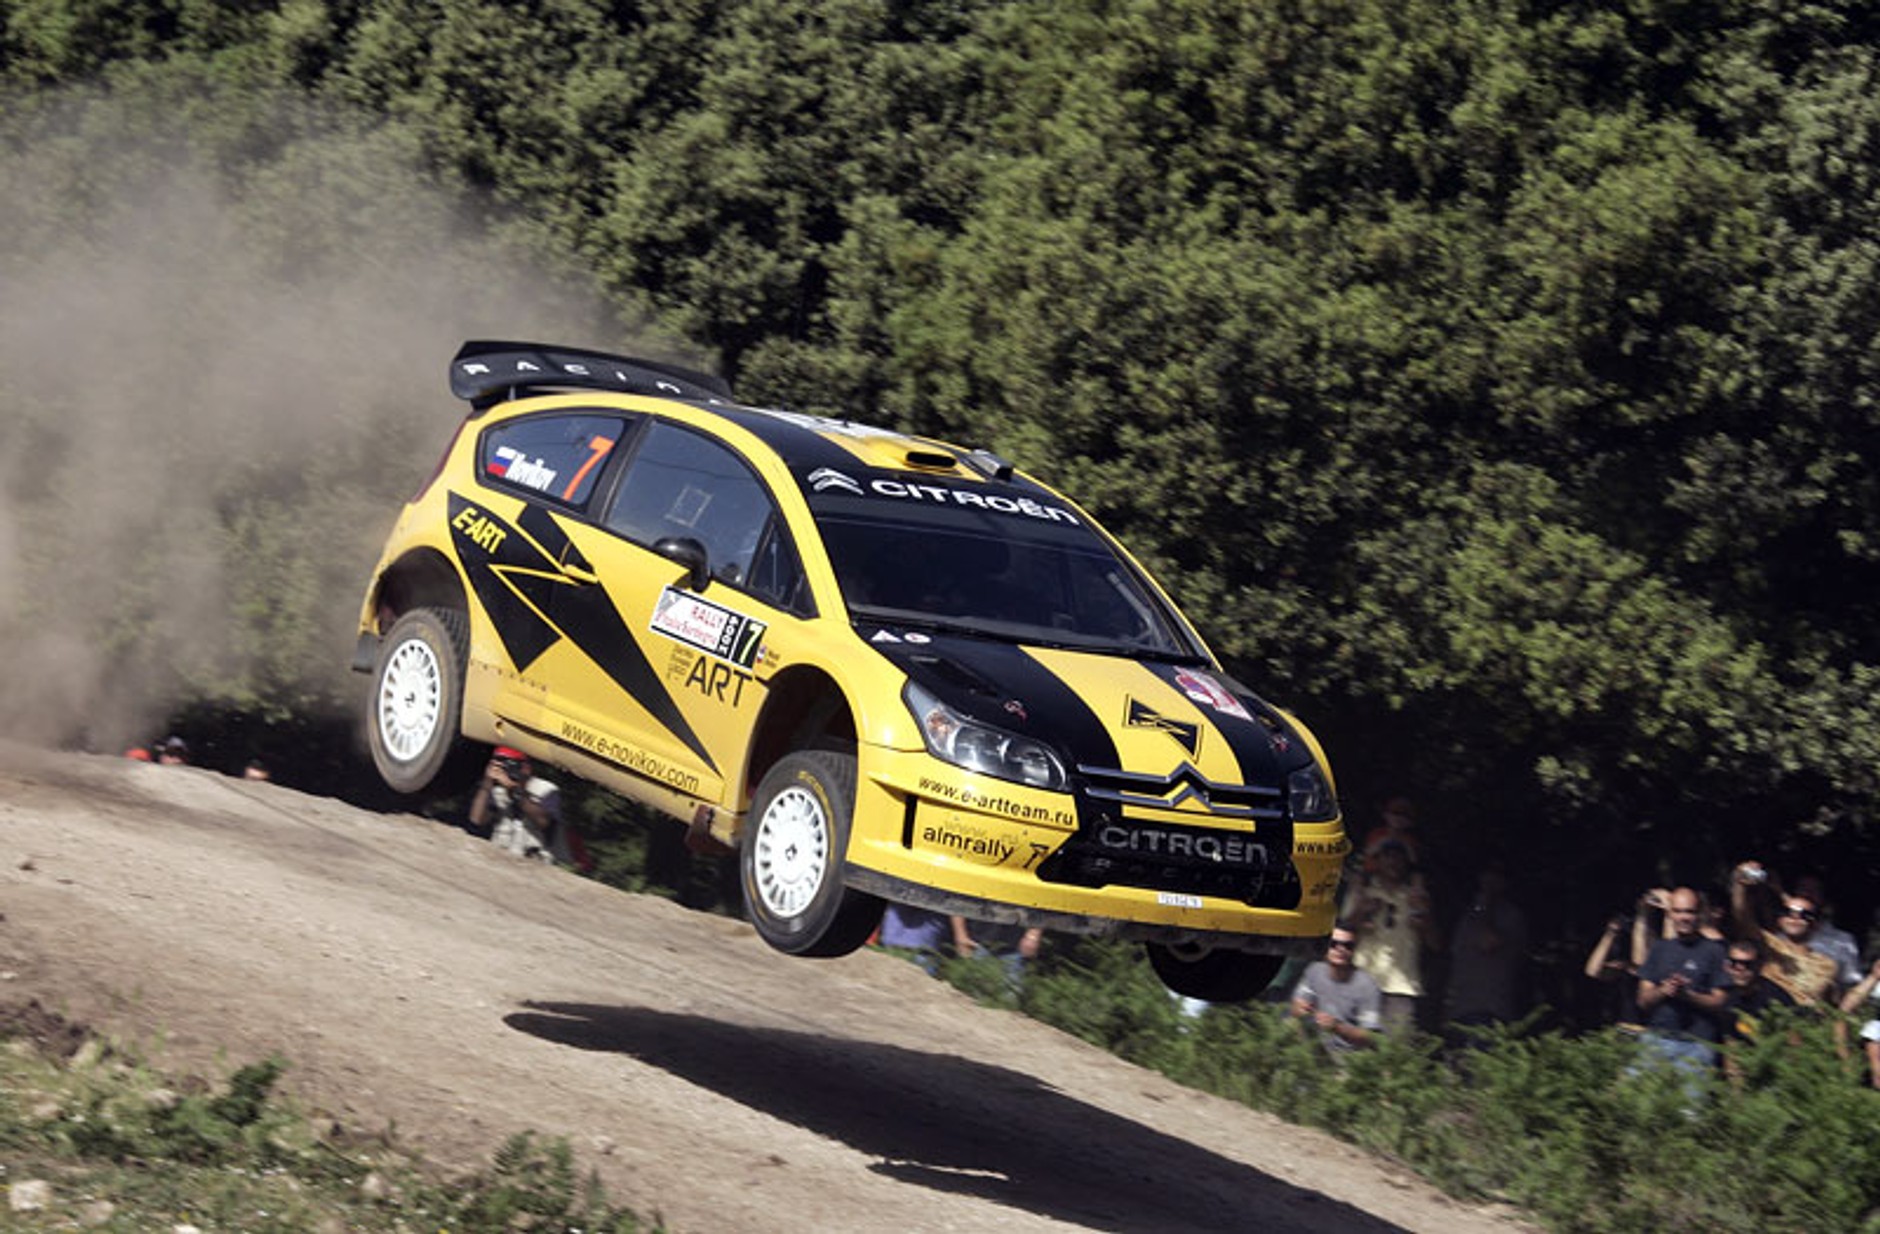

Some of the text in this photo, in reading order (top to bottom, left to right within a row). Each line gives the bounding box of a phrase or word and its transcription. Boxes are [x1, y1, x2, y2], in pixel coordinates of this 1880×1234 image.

[561, 435, 616, 502] 7
[451, 507, 507, 554] E-ART
[739, 621, 764, 665] 7
[685, 655, 753, 708] ART
[561, 721, 700, 793] www.e-novikov.com
[918, 776, 1074, 826] www.e-artteam.ru
